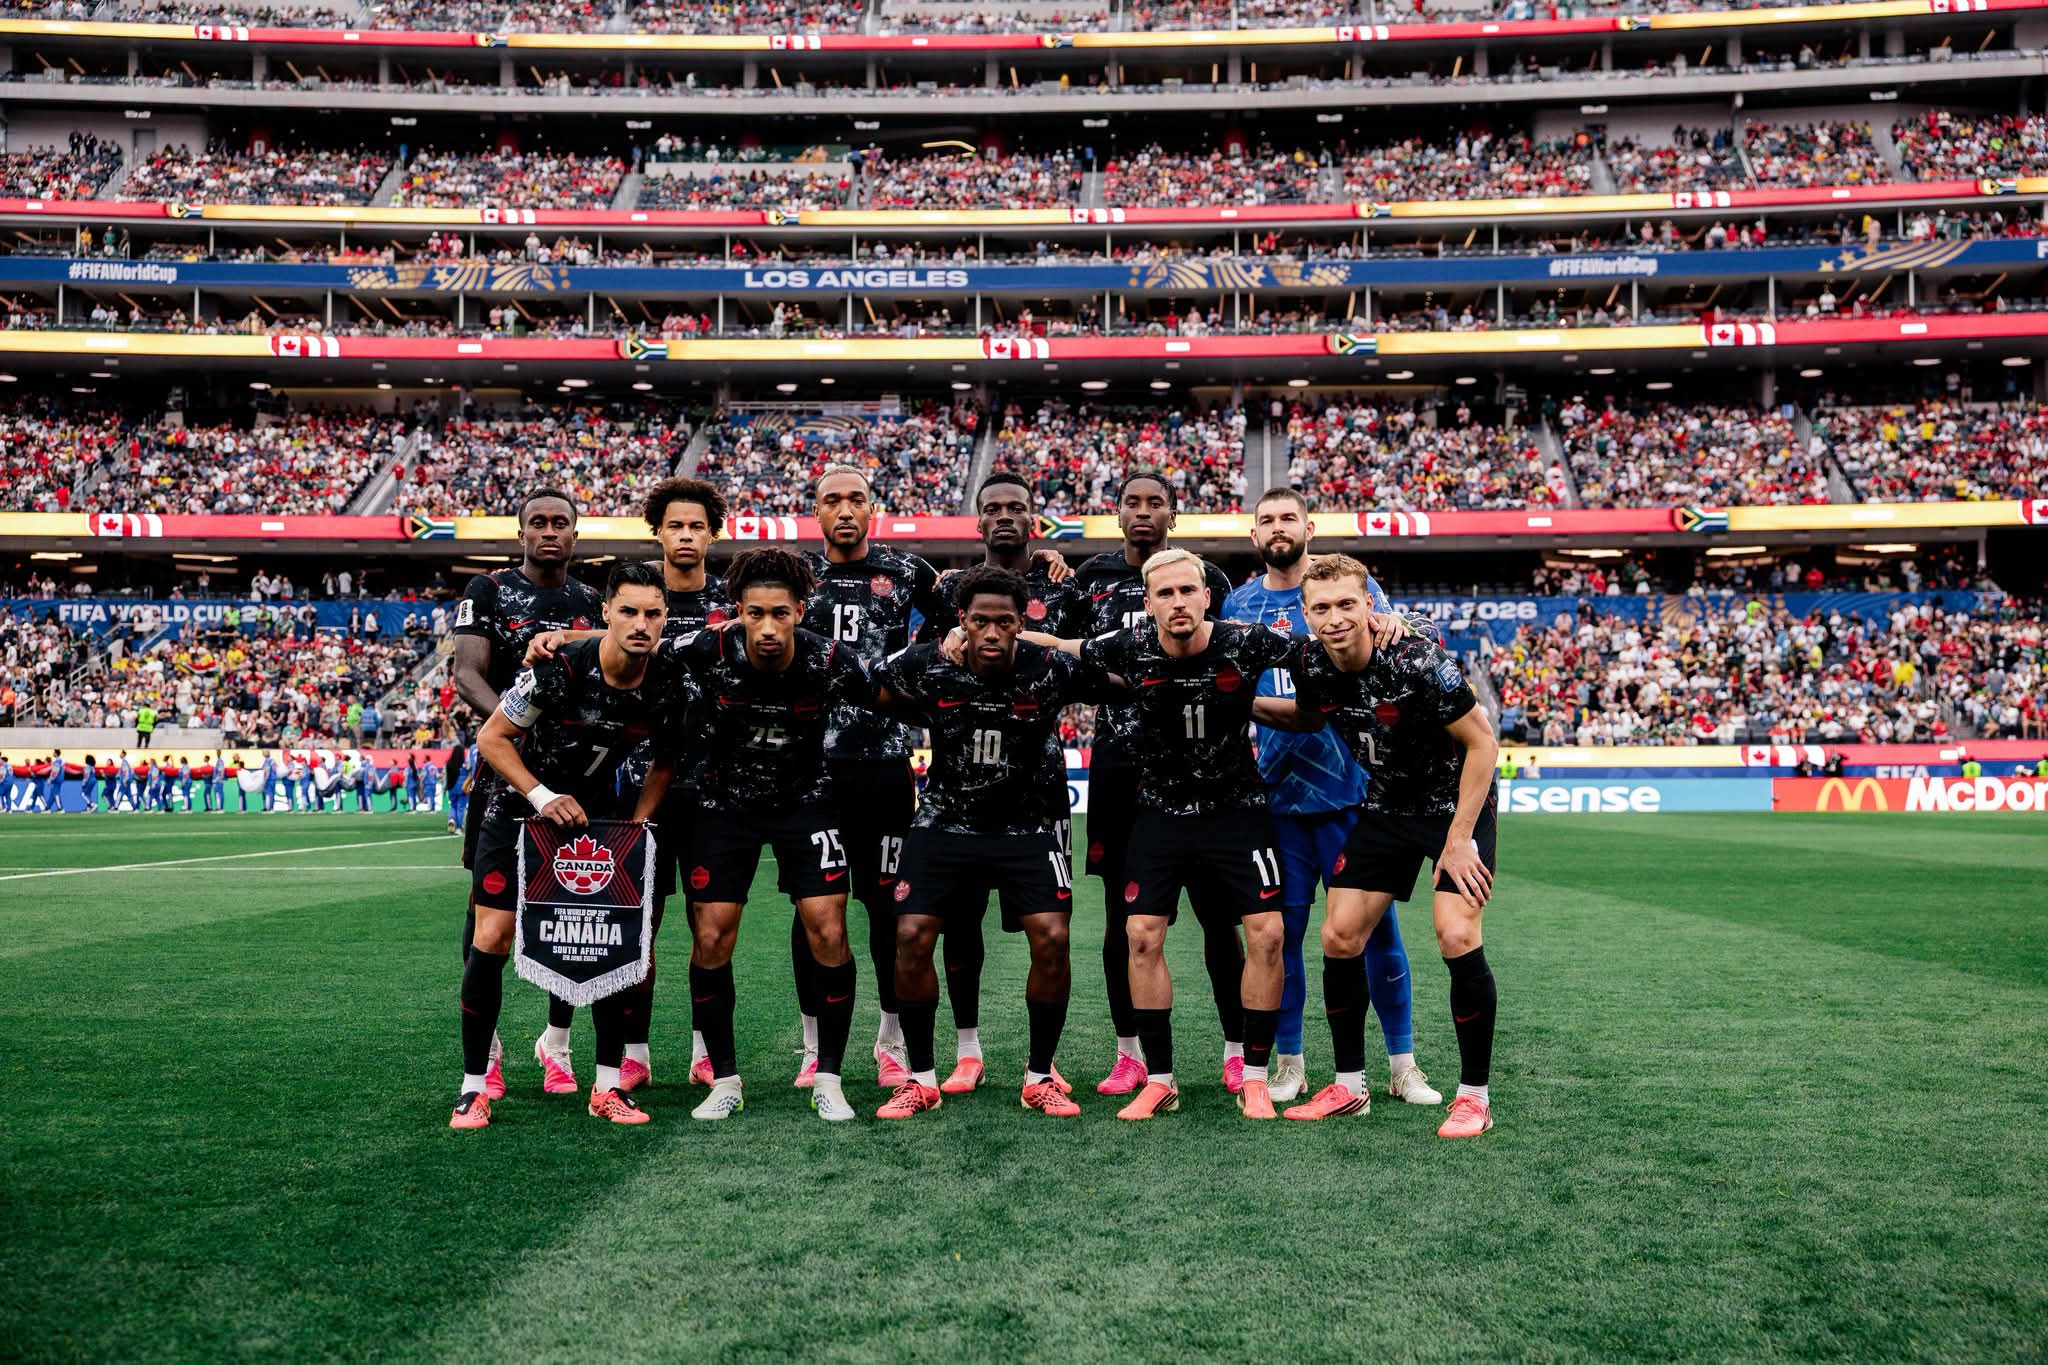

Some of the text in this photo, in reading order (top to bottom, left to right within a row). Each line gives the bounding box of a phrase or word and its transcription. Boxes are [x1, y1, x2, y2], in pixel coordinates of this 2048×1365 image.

[68, 262, 177, 284] #FIFAWorldCup
[744, 270, 968, 288] LOS ANGELES
[1549, 256, 1657, 277] #FIFAWorldCup
[59, 604, 106, 621] FIFA
[832, 603, 860, 642] 13
[1182, 704, 1205, 739] 11
[583, 745, 609, 777] 7
[972, 729, 1002, 765] 10
[1359, 732, 1384, 766] 2
[1875, 765, 1928, 778] FIFA
[1497, 779, 1660, 813] isense
[811, 828, 848, 869] 25
[880, 835, 903, 875] 13
[555, 861, 613, 872] CANADA
[1048, 851, 1072, 889] 10
[1252, 848, 1281, 886] 11
[554, 907, 566, 915] FIFA
[539, 920, 623, 946] CANADA
[552, 945, 608, 956] SOUTH AFRICA
